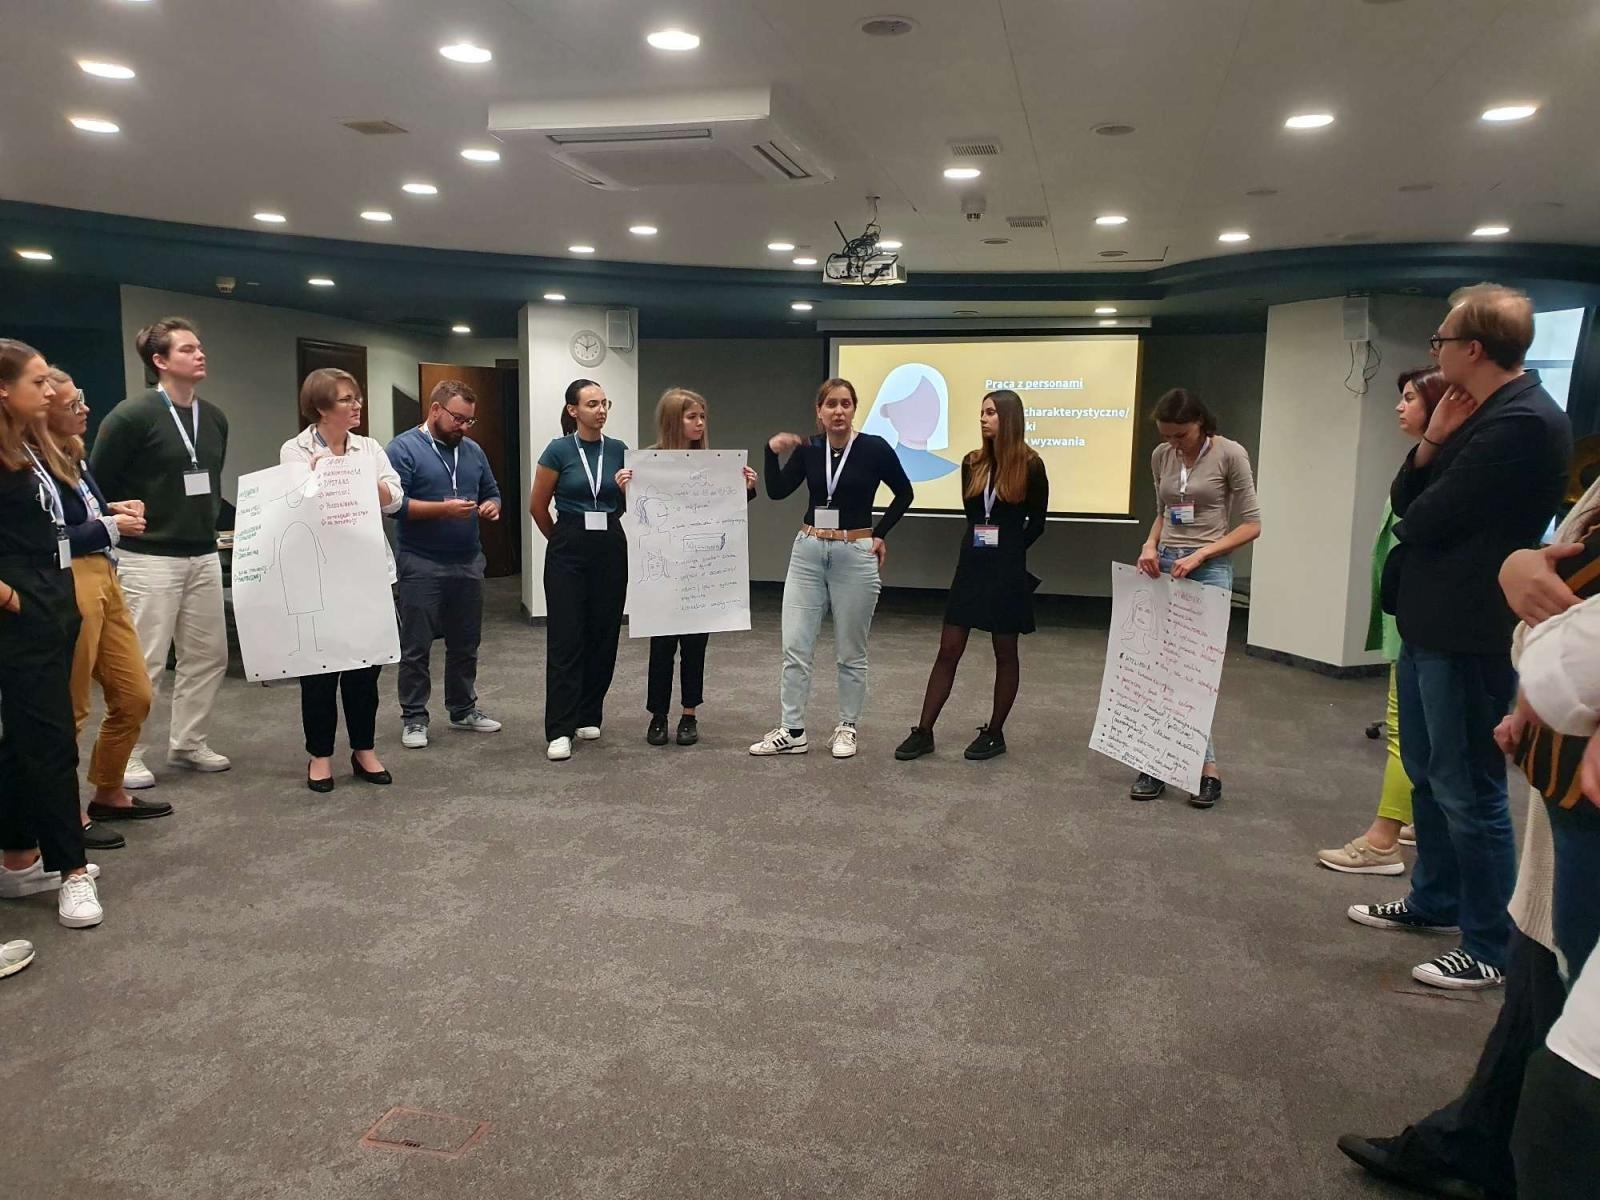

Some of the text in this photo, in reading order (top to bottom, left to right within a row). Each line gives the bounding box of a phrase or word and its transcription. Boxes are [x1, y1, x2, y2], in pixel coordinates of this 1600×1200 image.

[985, 378, 1083, 391] Praca z personami
[1031, 436, 1085, 447] wyzwania
